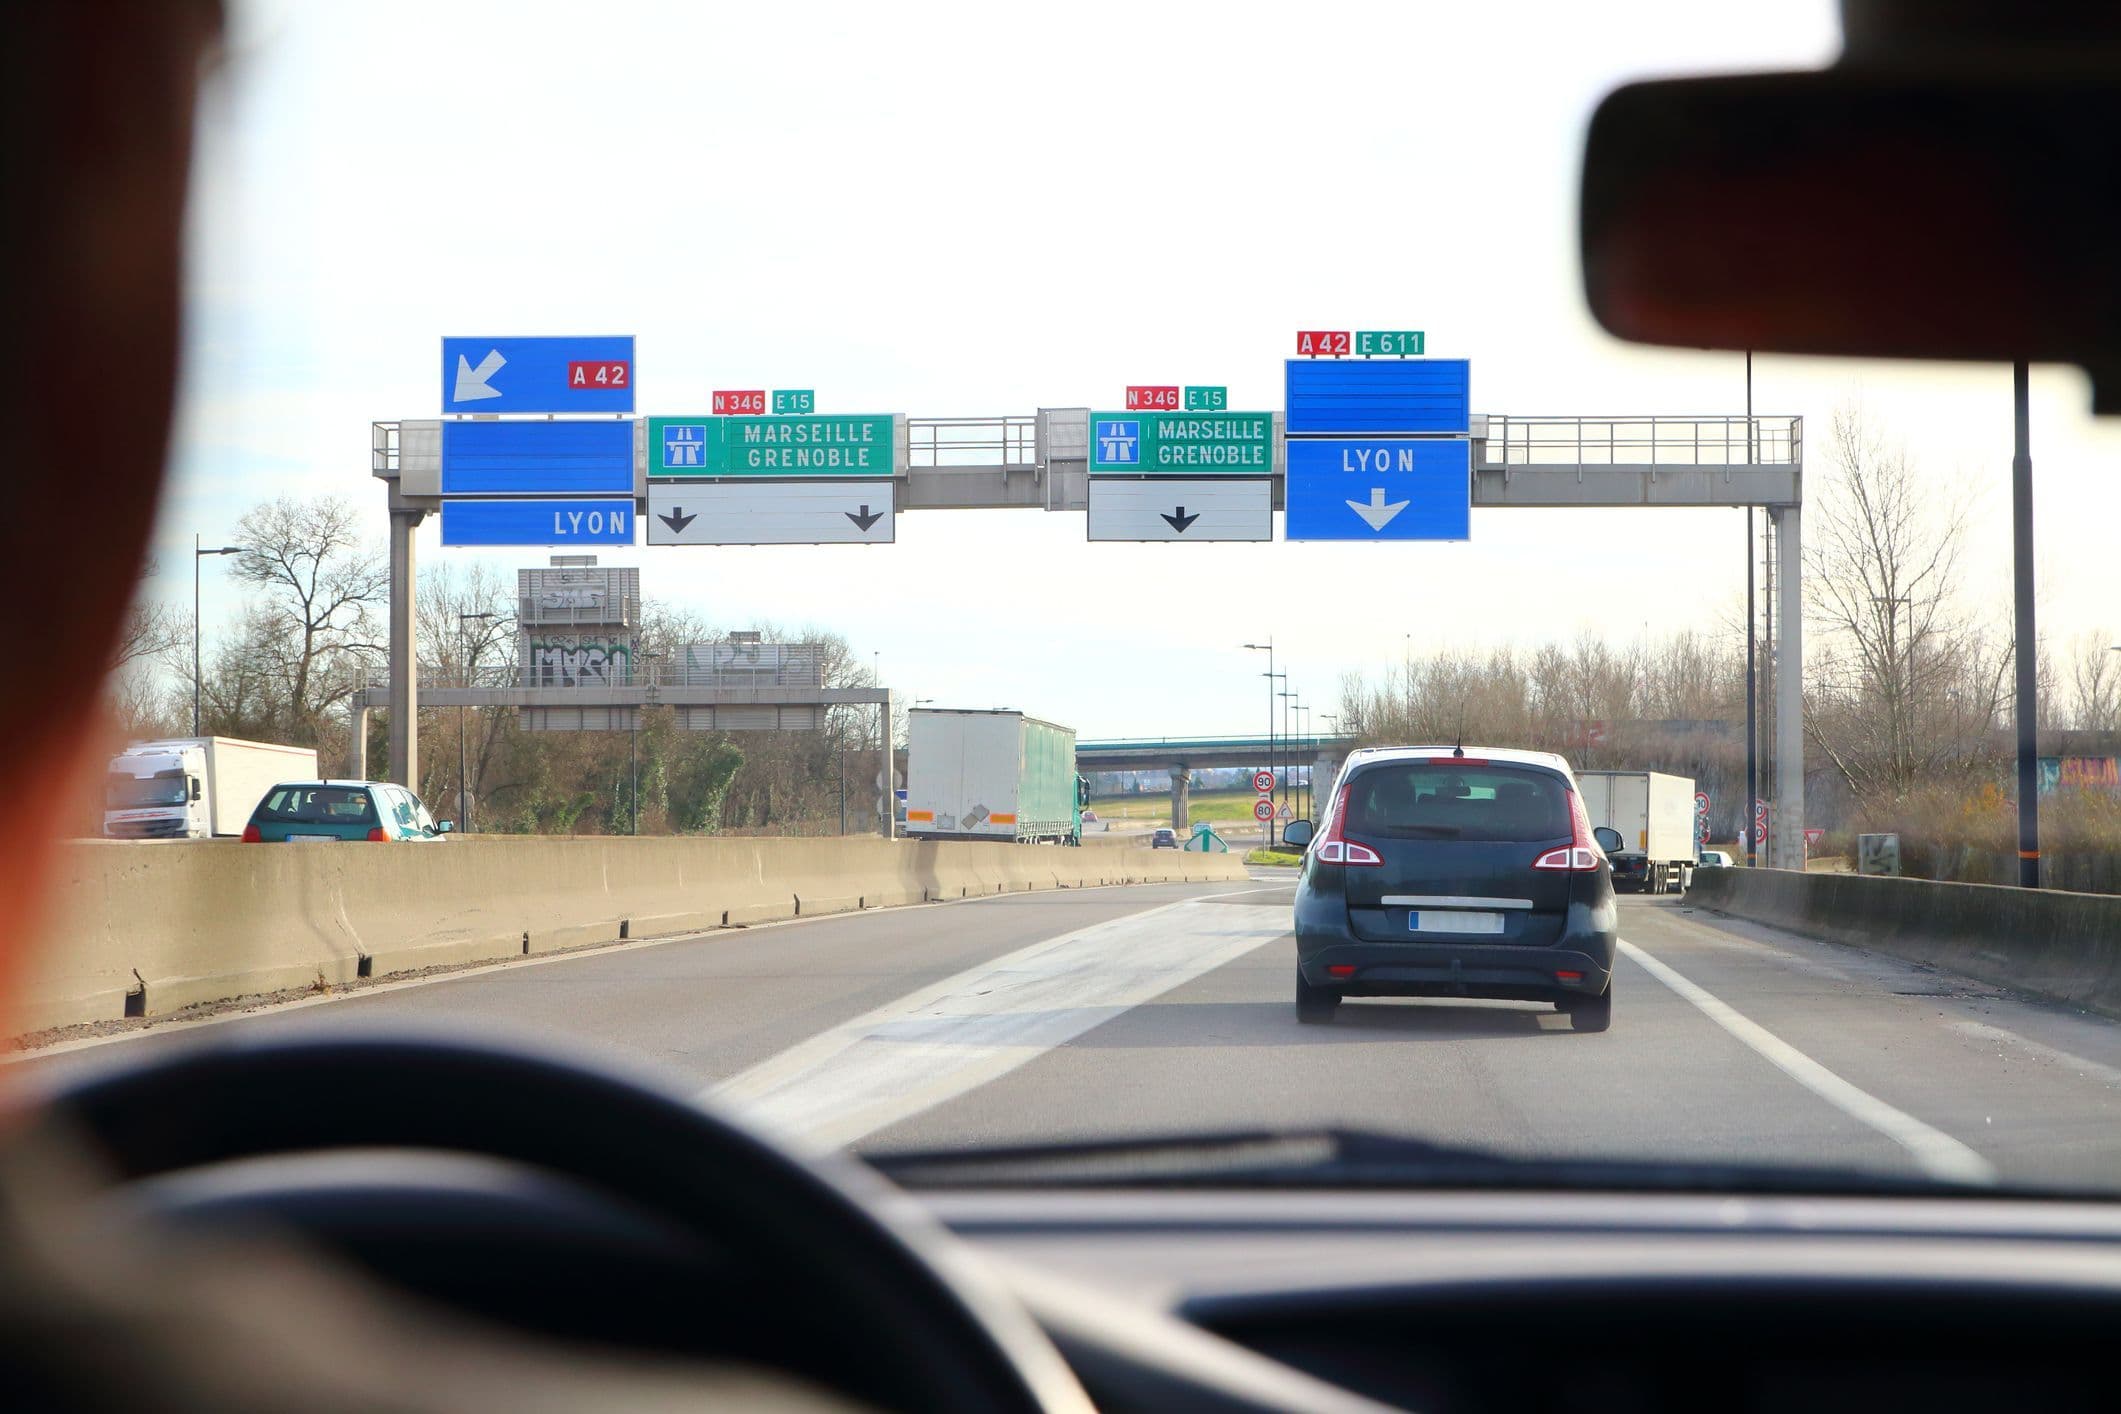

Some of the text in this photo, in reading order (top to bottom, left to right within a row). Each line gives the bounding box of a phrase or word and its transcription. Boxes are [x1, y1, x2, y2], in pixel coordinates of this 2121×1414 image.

[1301, 334, 1347, 352] A 42
[1362, 334, 1419, 352] E 611
[573, 365, 624, 384] A 42
[715, 395, 762, 410] N 346
[777, 395, 809, 409] E 15
[1128, 391, 1176, 405] N 346
[1189, 391, 1222, 405] E 15
[744, 424, 873, 443] MARSEILLE
[1158, 421, 1264, 439] MARSEILLE
[749, 448, 869, 467] GRENOBLE
[1158, 445, 1264, 464] GRENOBLE
[1343, 449, 1413, 472] LYON
[554, 512, 625, 534] LYON
[1258, 777, 1271, 787] 90
[1258, 806, 1271, 816] 80
